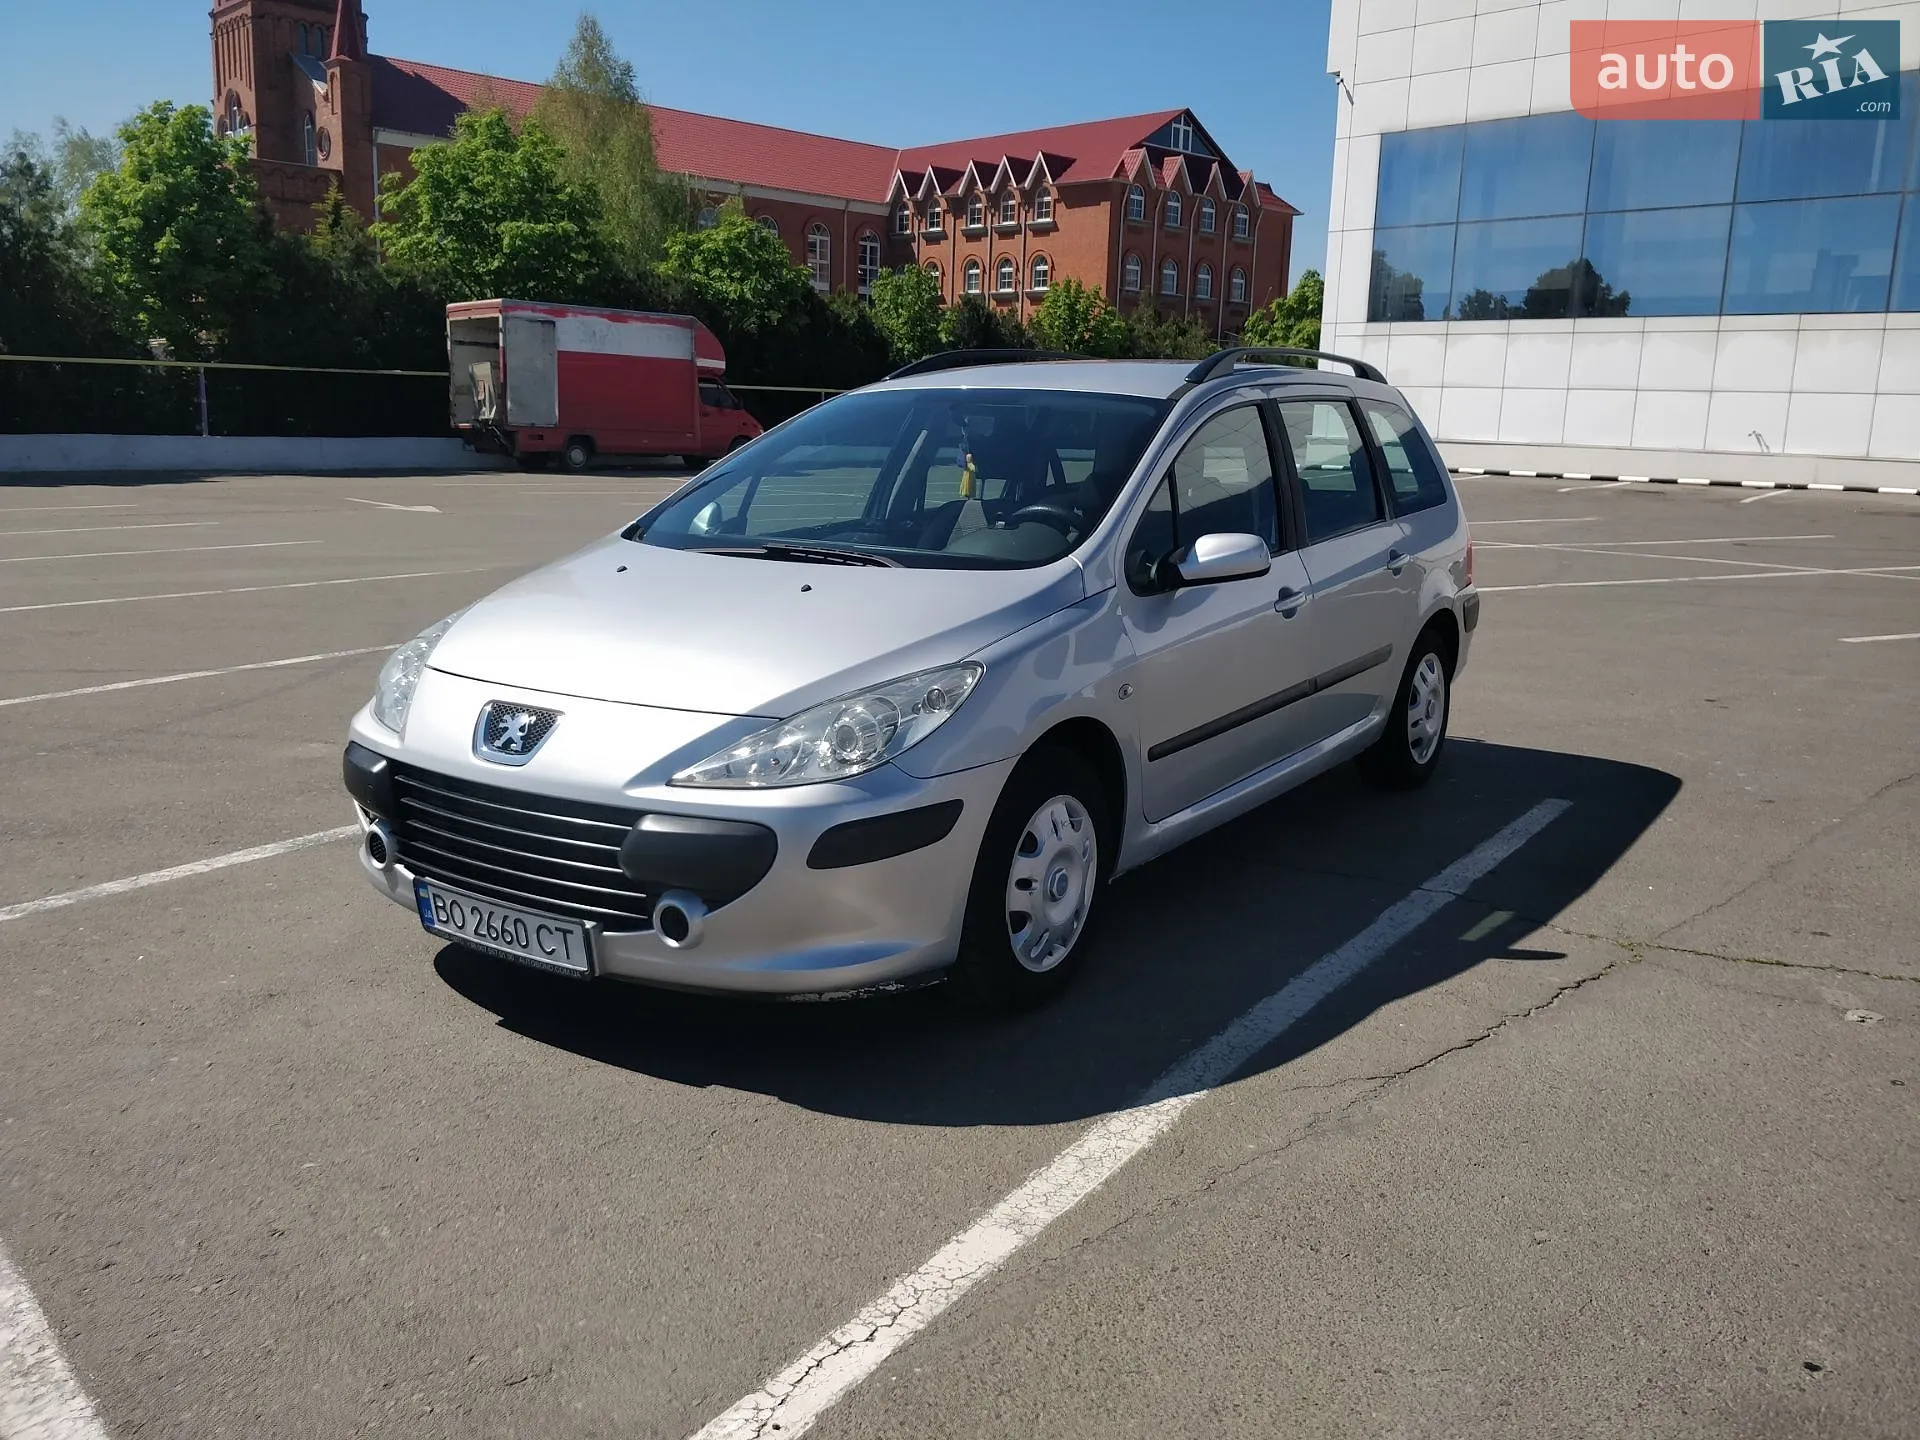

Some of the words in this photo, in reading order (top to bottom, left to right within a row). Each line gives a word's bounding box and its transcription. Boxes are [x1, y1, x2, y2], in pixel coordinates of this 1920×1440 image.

[432, 894, 466, 930] BO
[470, 906, 529, 949] 2660
[536, 923, 574, 960] CT
